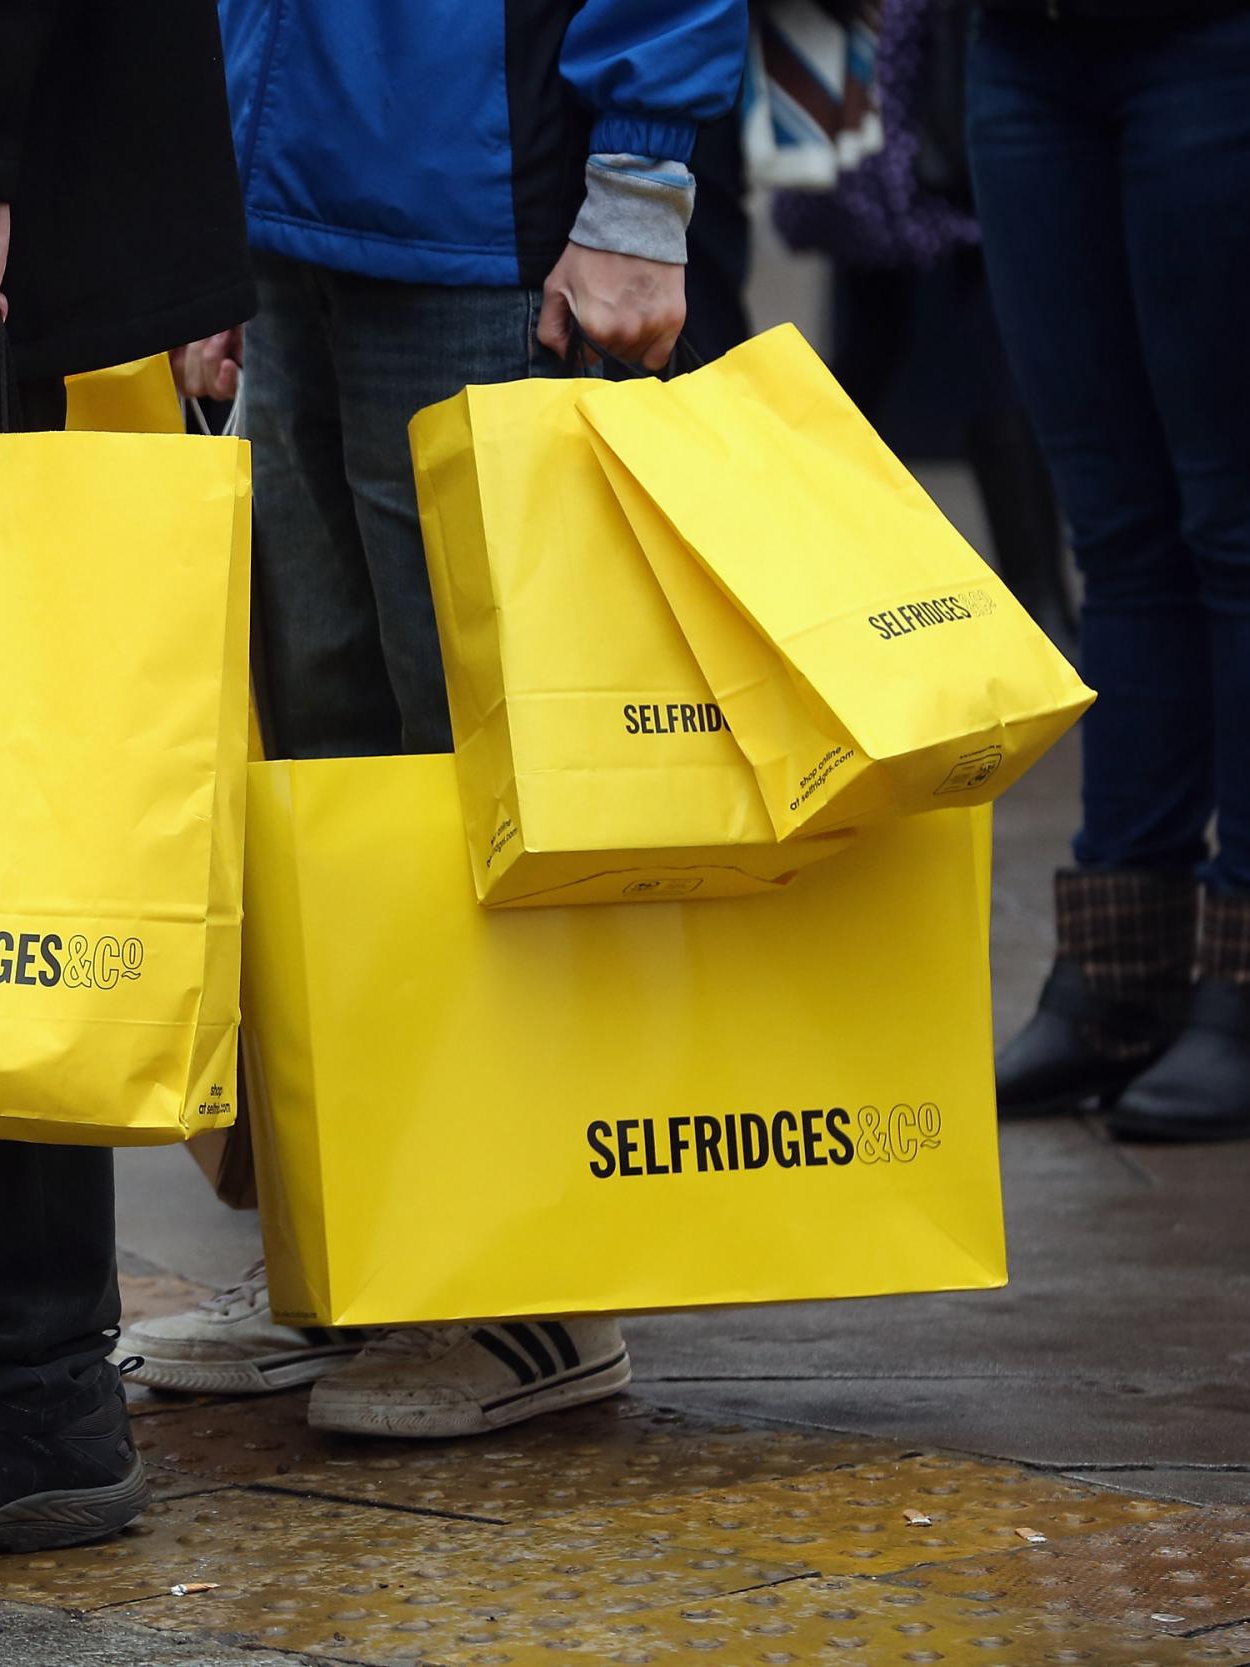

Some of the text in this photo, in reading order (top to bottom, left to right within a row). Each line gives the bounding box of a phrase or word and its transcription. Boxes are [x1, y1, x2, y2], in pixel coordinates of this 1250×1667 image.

[790, 749, 854, 811] at selfridges.com
[800, 746, 842, 788] shop online
[198, 1101, 207, 1114] at
